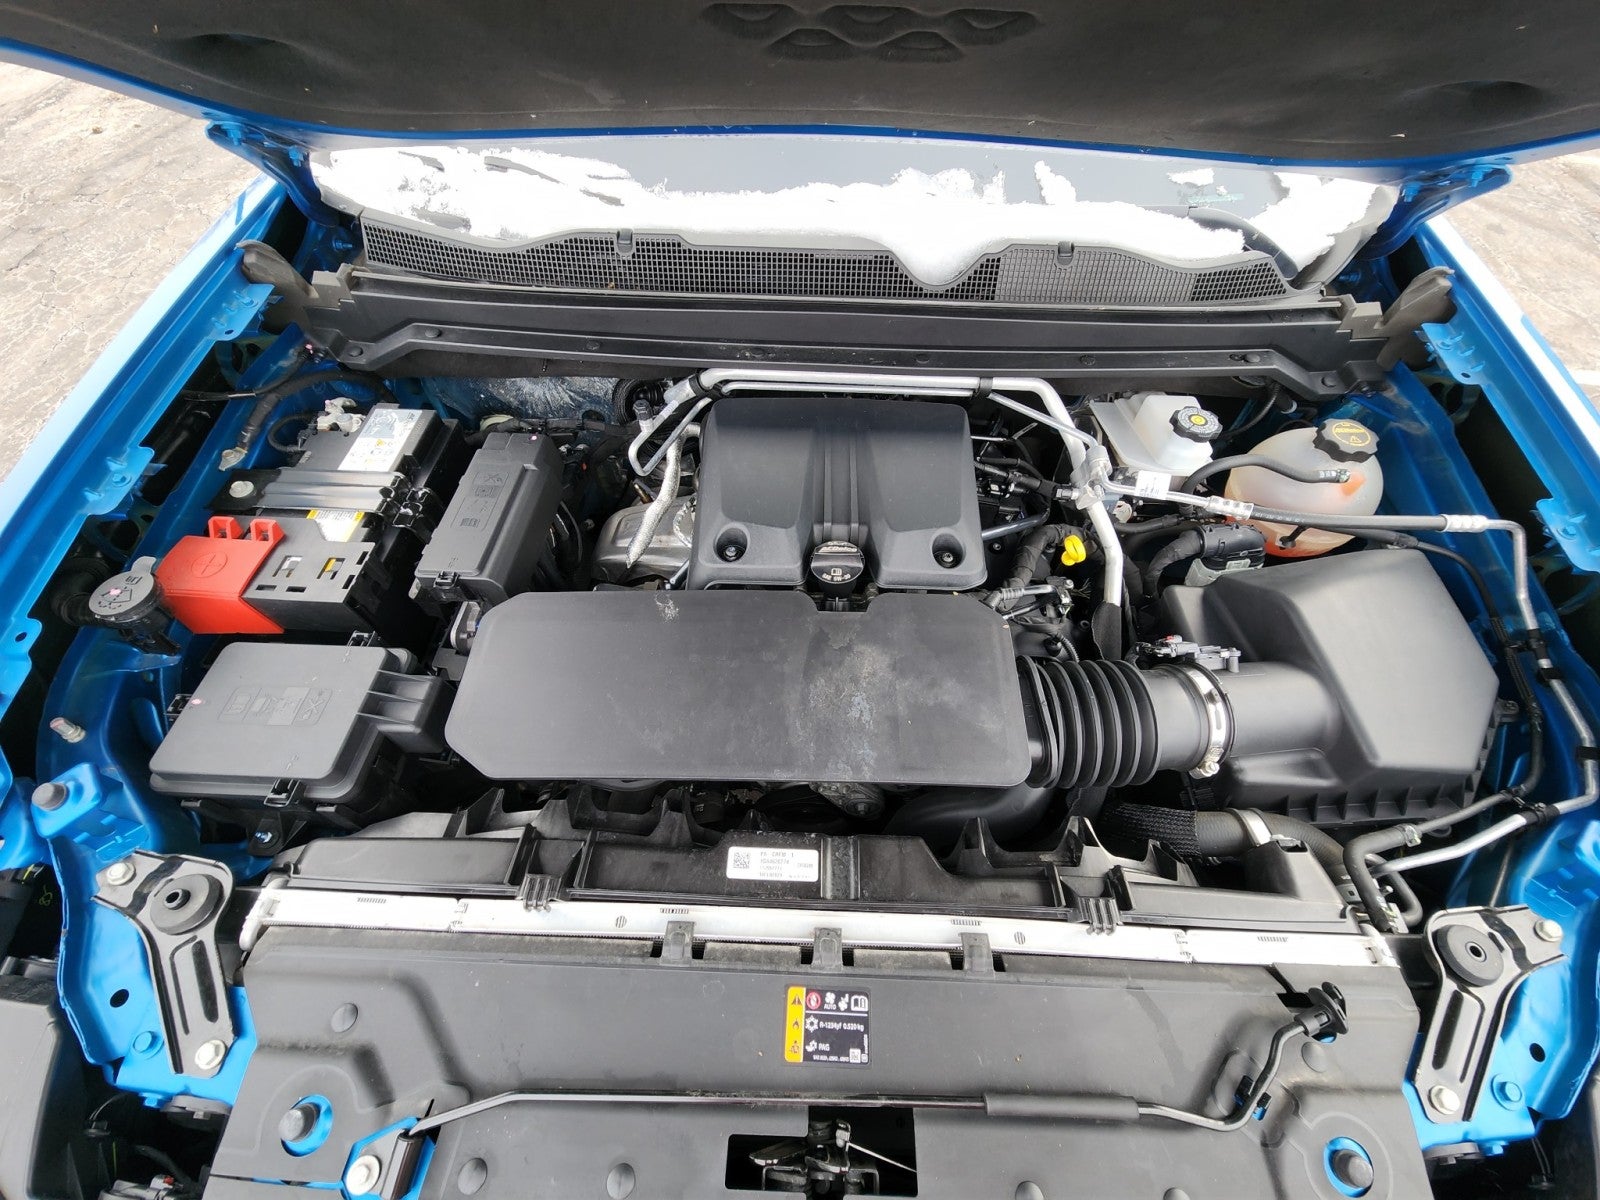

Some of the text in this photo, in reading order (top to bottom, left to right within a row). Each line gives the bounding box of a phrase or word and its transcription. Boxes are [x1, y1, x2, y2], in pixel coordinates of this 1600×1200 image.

[819, 1021, 842, 1031] R-1234yf
[857, 1023, 865, 1032] kg
[818, 1043, 830, 1052] PAG
